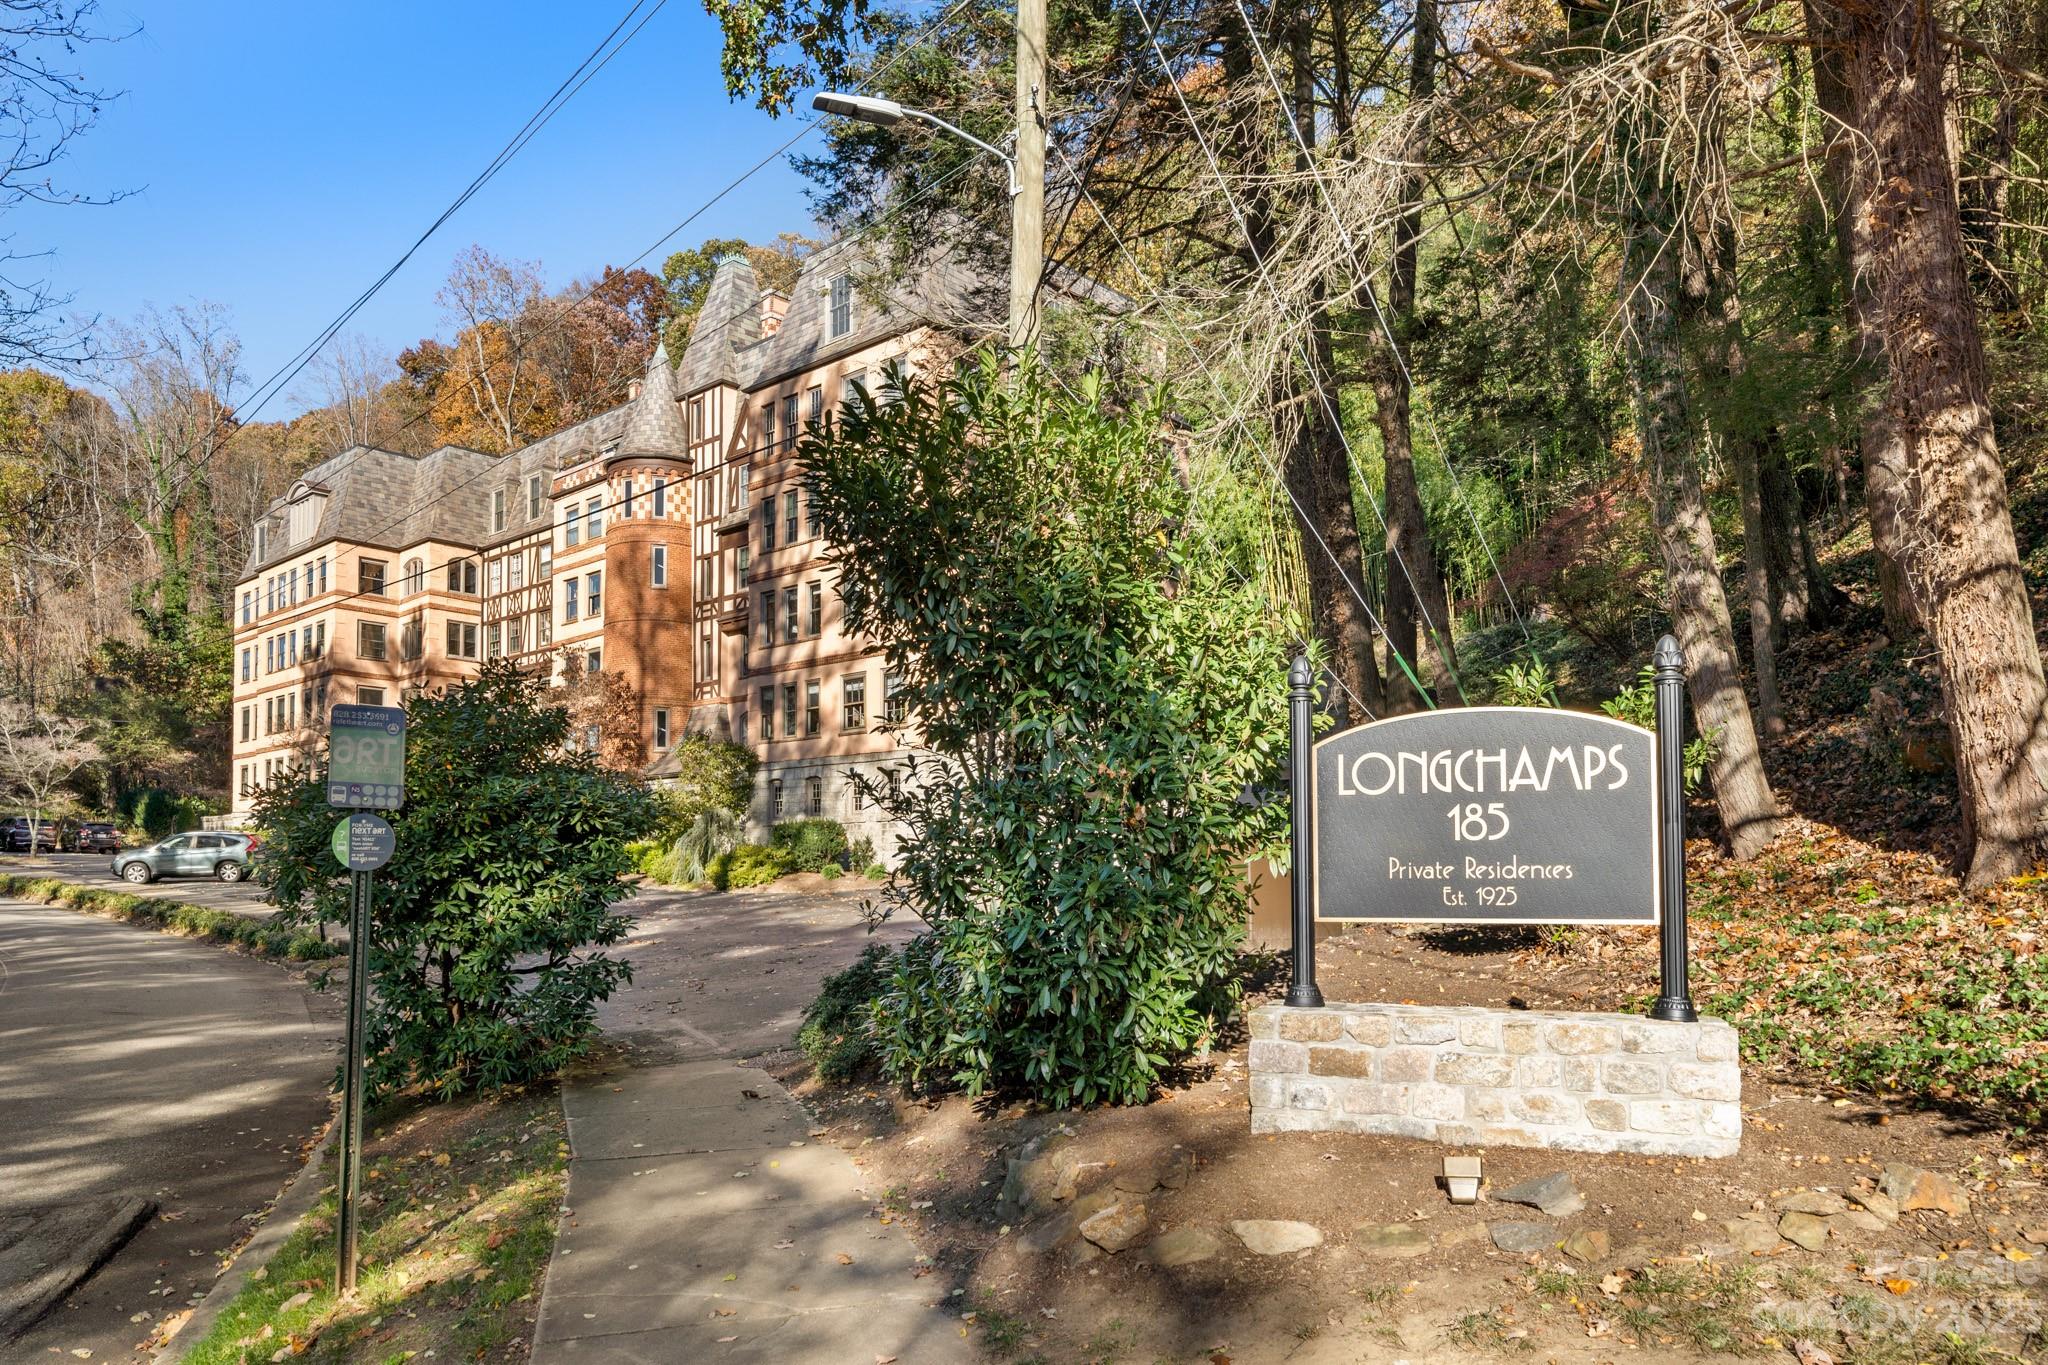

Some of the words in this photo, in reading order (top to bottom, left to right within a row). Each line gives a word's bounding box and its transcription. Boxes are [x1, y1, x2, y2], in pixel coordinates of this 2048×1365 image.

[1338, 744, 1629, 796] LONGCHAMPS
[1447, 802, 1510, 841] 185
[1389, 857, 1455, 881] Private
[1465, 855, 1573, 880] Residences
[1443, 887, 1467, 906] Est.
[1476, 887, 1518, 907] 1925
